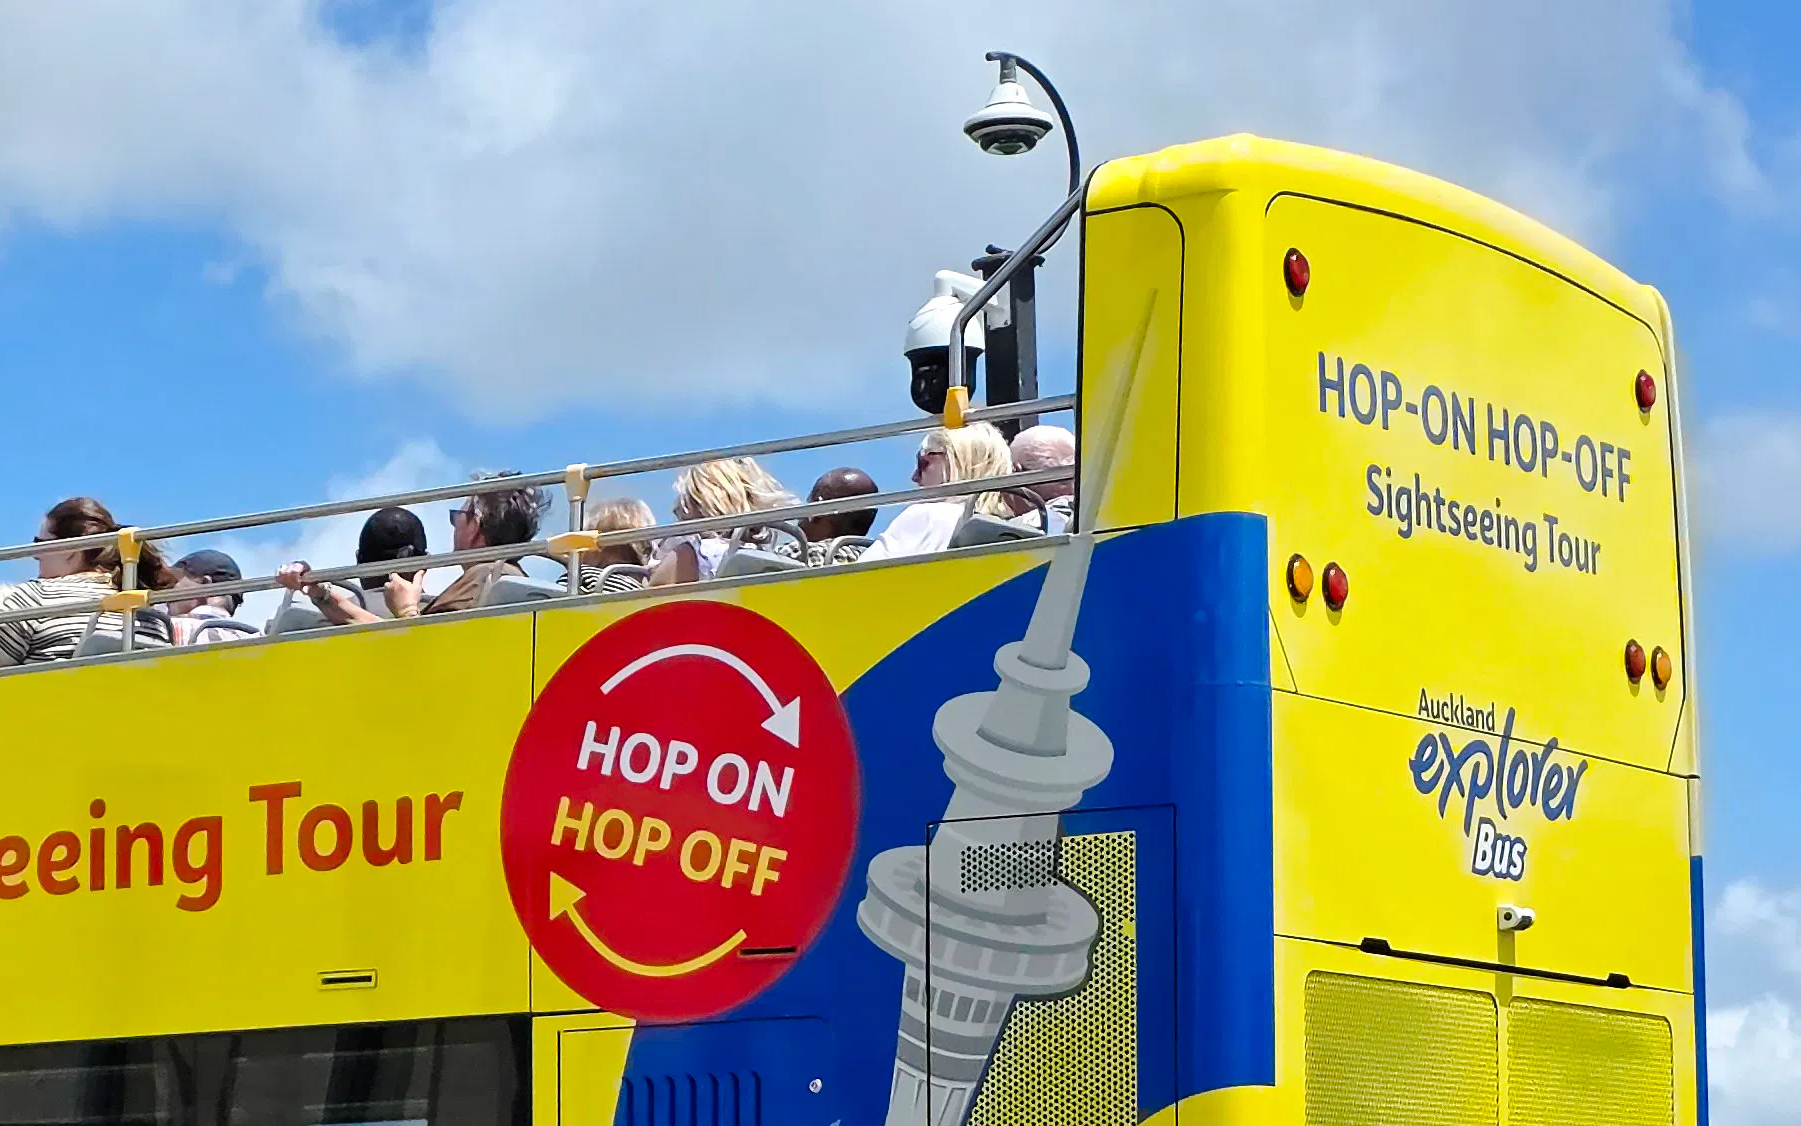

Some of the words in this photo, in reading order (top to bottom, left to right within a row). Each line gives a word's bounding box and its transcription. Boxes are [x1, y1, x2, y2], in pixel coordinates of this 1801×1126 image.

[1317, 351, 1477, 455] HOP-ON
[1486, 401, 1632, 503] HOP-OFF
[1365, 463, 1538, 573] Sightseeing
[1542, 513, 1601, 575] Tour
[1417, 687, 1496, 732] Auckland
[578, 720, 698, 790] HOP
[706, 750, 795, 818] ON
[1408, 706, 1588, 837] explorer
[248, 780, 463, 876] Tour
[552, 796, 672, 867] HOP
[678, 826, 788, 898] OFF
[1471, 817, 1527, 882] Bus
